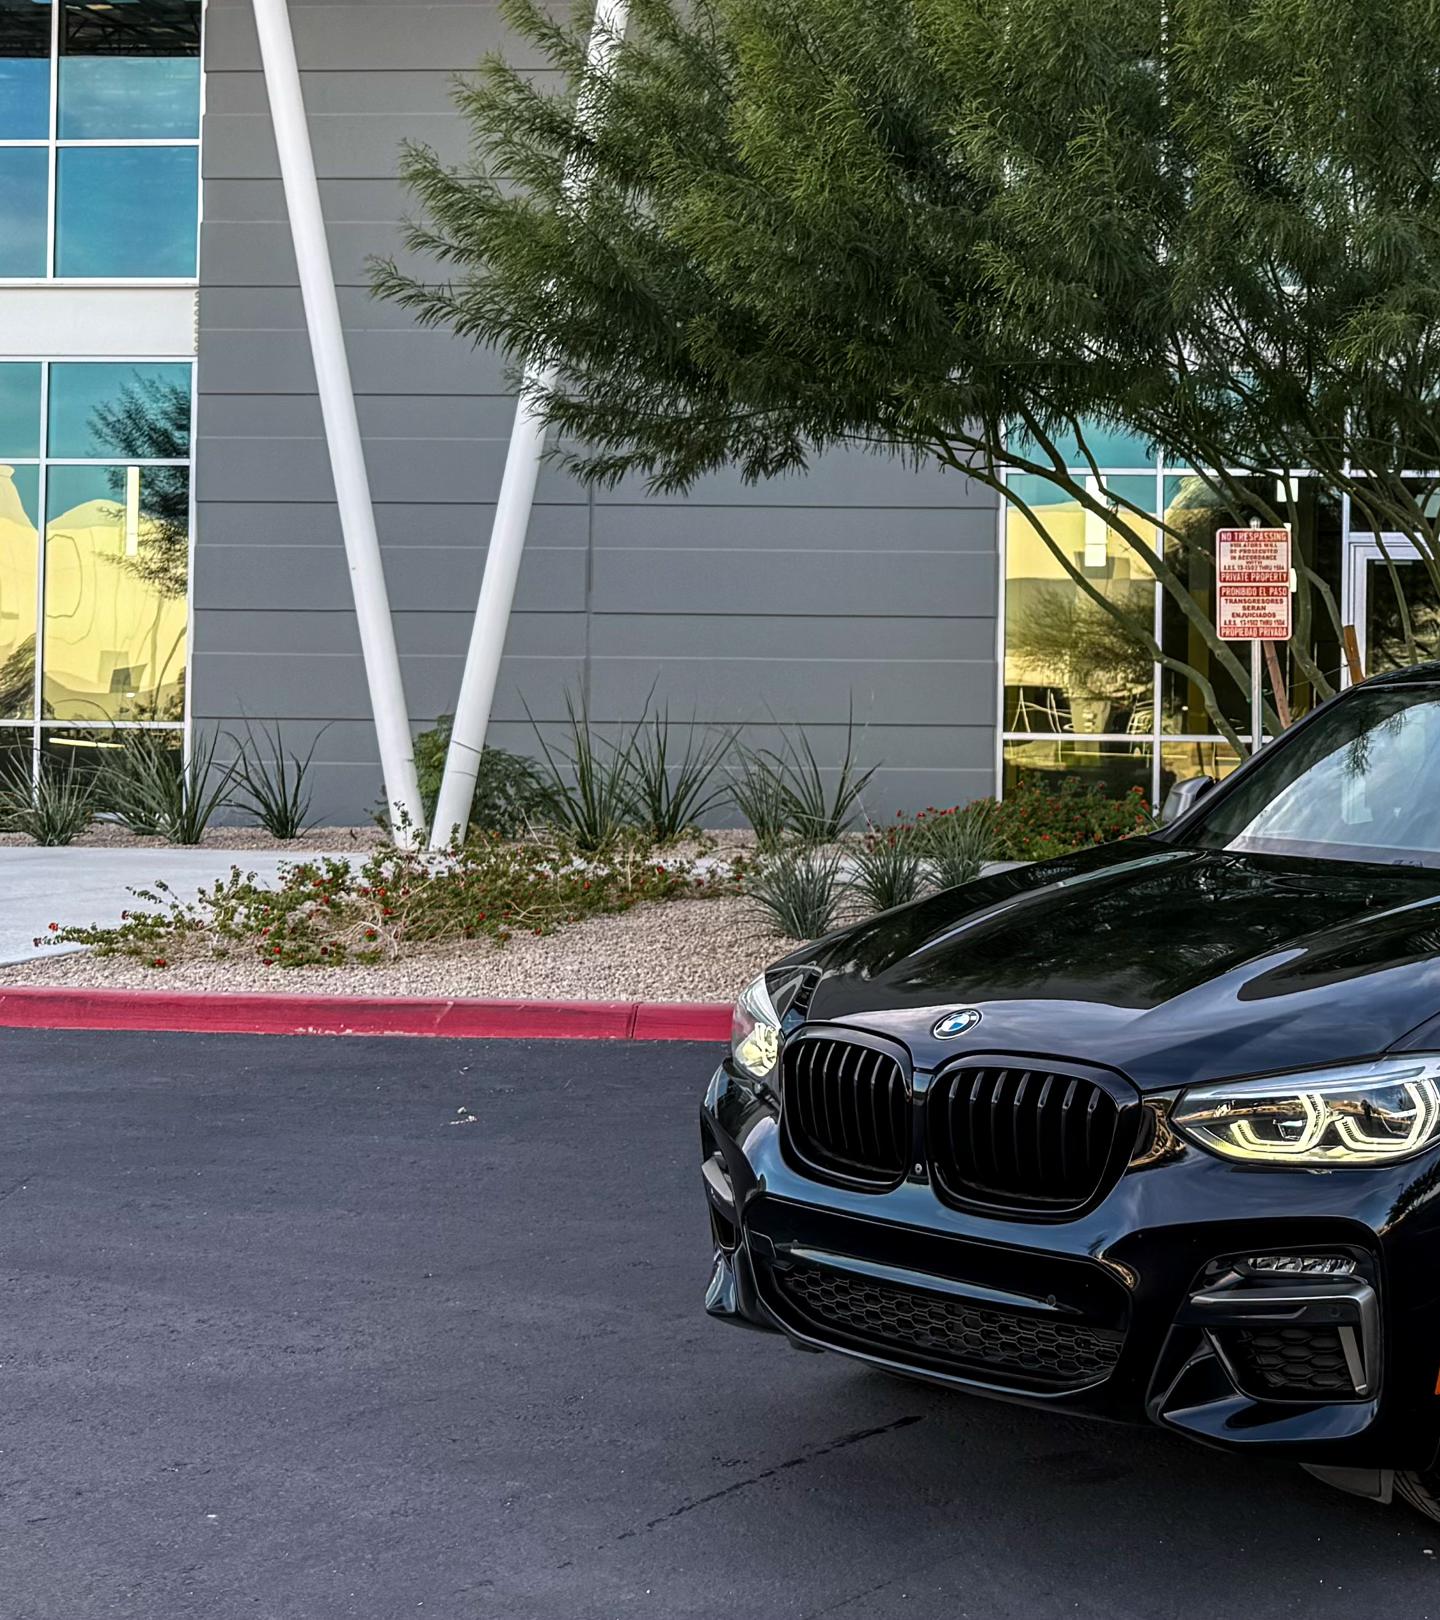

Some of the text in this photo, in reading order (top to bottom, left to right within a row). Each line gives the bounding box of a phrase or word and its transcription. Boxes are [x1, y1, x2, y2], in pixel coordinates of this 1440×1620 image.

[1221, 532, 1287, 540] NO TRESPASSING
[1221, 573, 1287, 582] PRIVATE PROPERTY
[1221, 587, 1287, 596] PROHIBIDO EL PASO
[1221, 628, 1287, 637] PROPIEDAD PRIVADA
